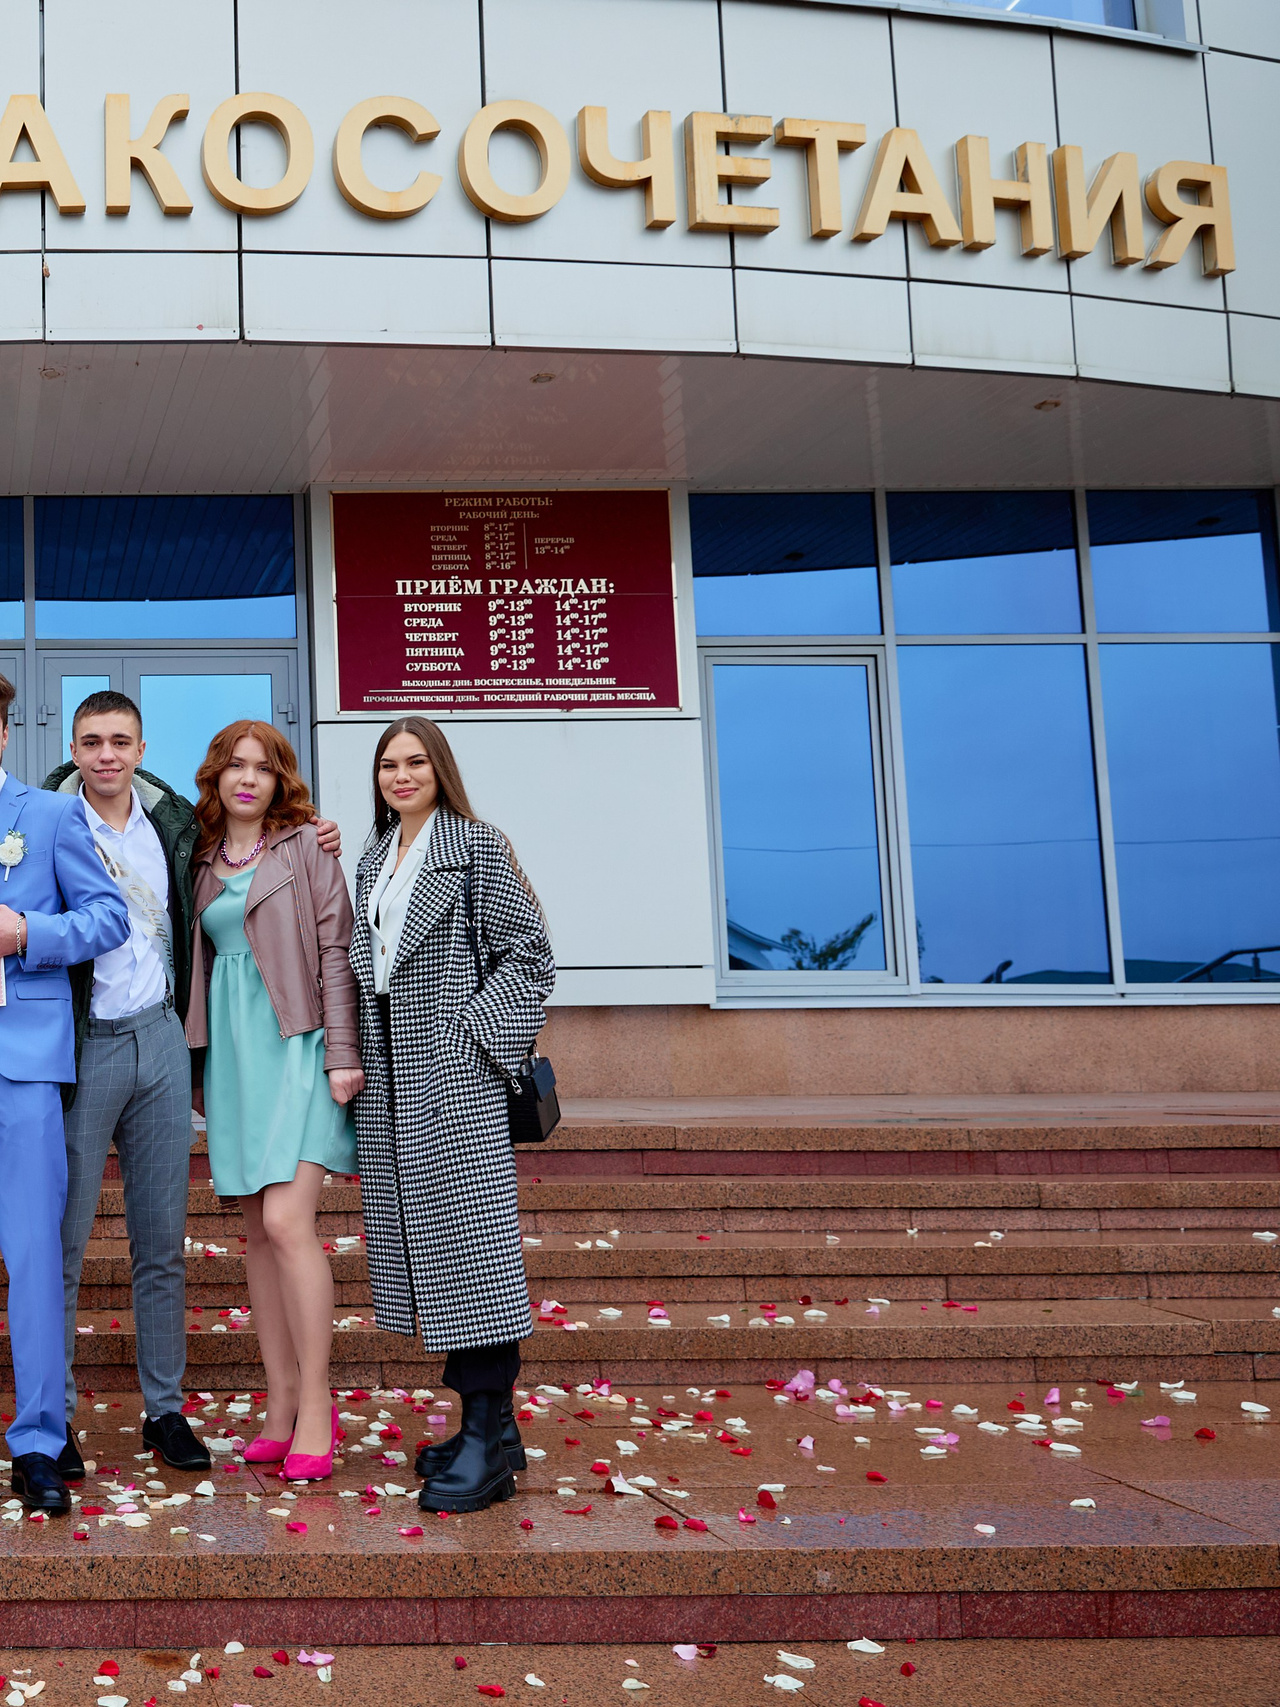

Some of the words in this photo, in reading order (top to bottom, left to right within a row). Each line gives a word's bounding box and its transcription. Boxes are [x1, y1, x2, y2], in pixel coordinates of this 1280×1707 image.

[445, 498, 493, 507] РЕЖИМ
[496, 497, 553, 506] РАБОТЫ:
[459, 510, 507, 519] РАБОЧИЙ
[510, 511, 540, 519] ДЕНЬ:
[395, 575, 483, 595] ПРИЁМ
[488, 578, 615, 598] ГРАЖДАН:
[404, 603, 462, 612] ВТОРНИК
[404, 618, 444, 628] СРЕДА
[405, 633, 459, 642] ЧЕТВЕРГ
[406, 648, 465, 658] ПЯТНИЦА
[406, 662, 461, 672] СУББОТА
[545, 678, 616, 686] ПОНЕДЕЛЬНИК
[455, 695, 480, 703] ДЕНЬ:
[484, 693, 542, 702] ПОСЛЕДНИЙ
[590, 693, 615, 701] ДЕНЬ
[617, 693, 656, 701] МЕСЯЦА
